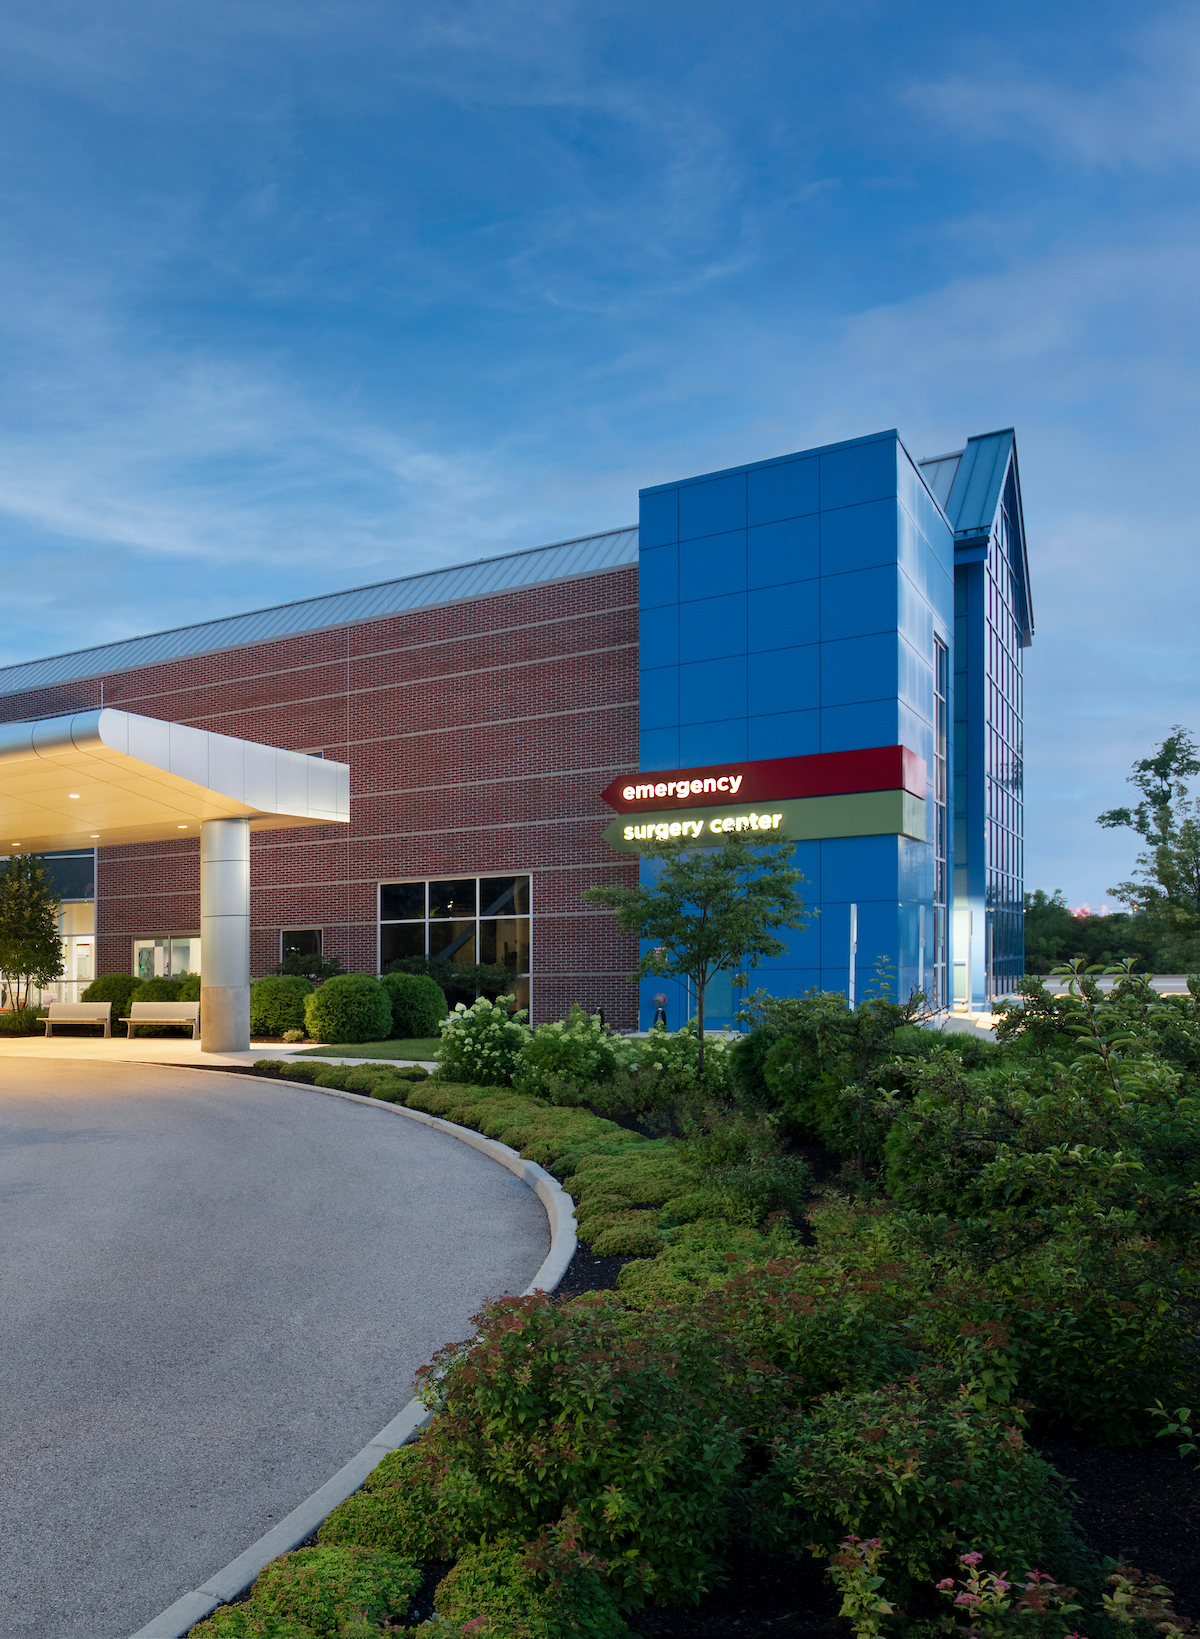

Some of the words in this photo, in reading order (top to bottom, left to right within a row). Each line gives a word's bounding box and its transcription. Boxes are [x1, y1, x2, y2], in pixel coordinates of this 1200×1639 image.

[623, 775, 742, 800] emergency
[622, 819, 704, 841] surgery
[710, 812, 782, 834] center
